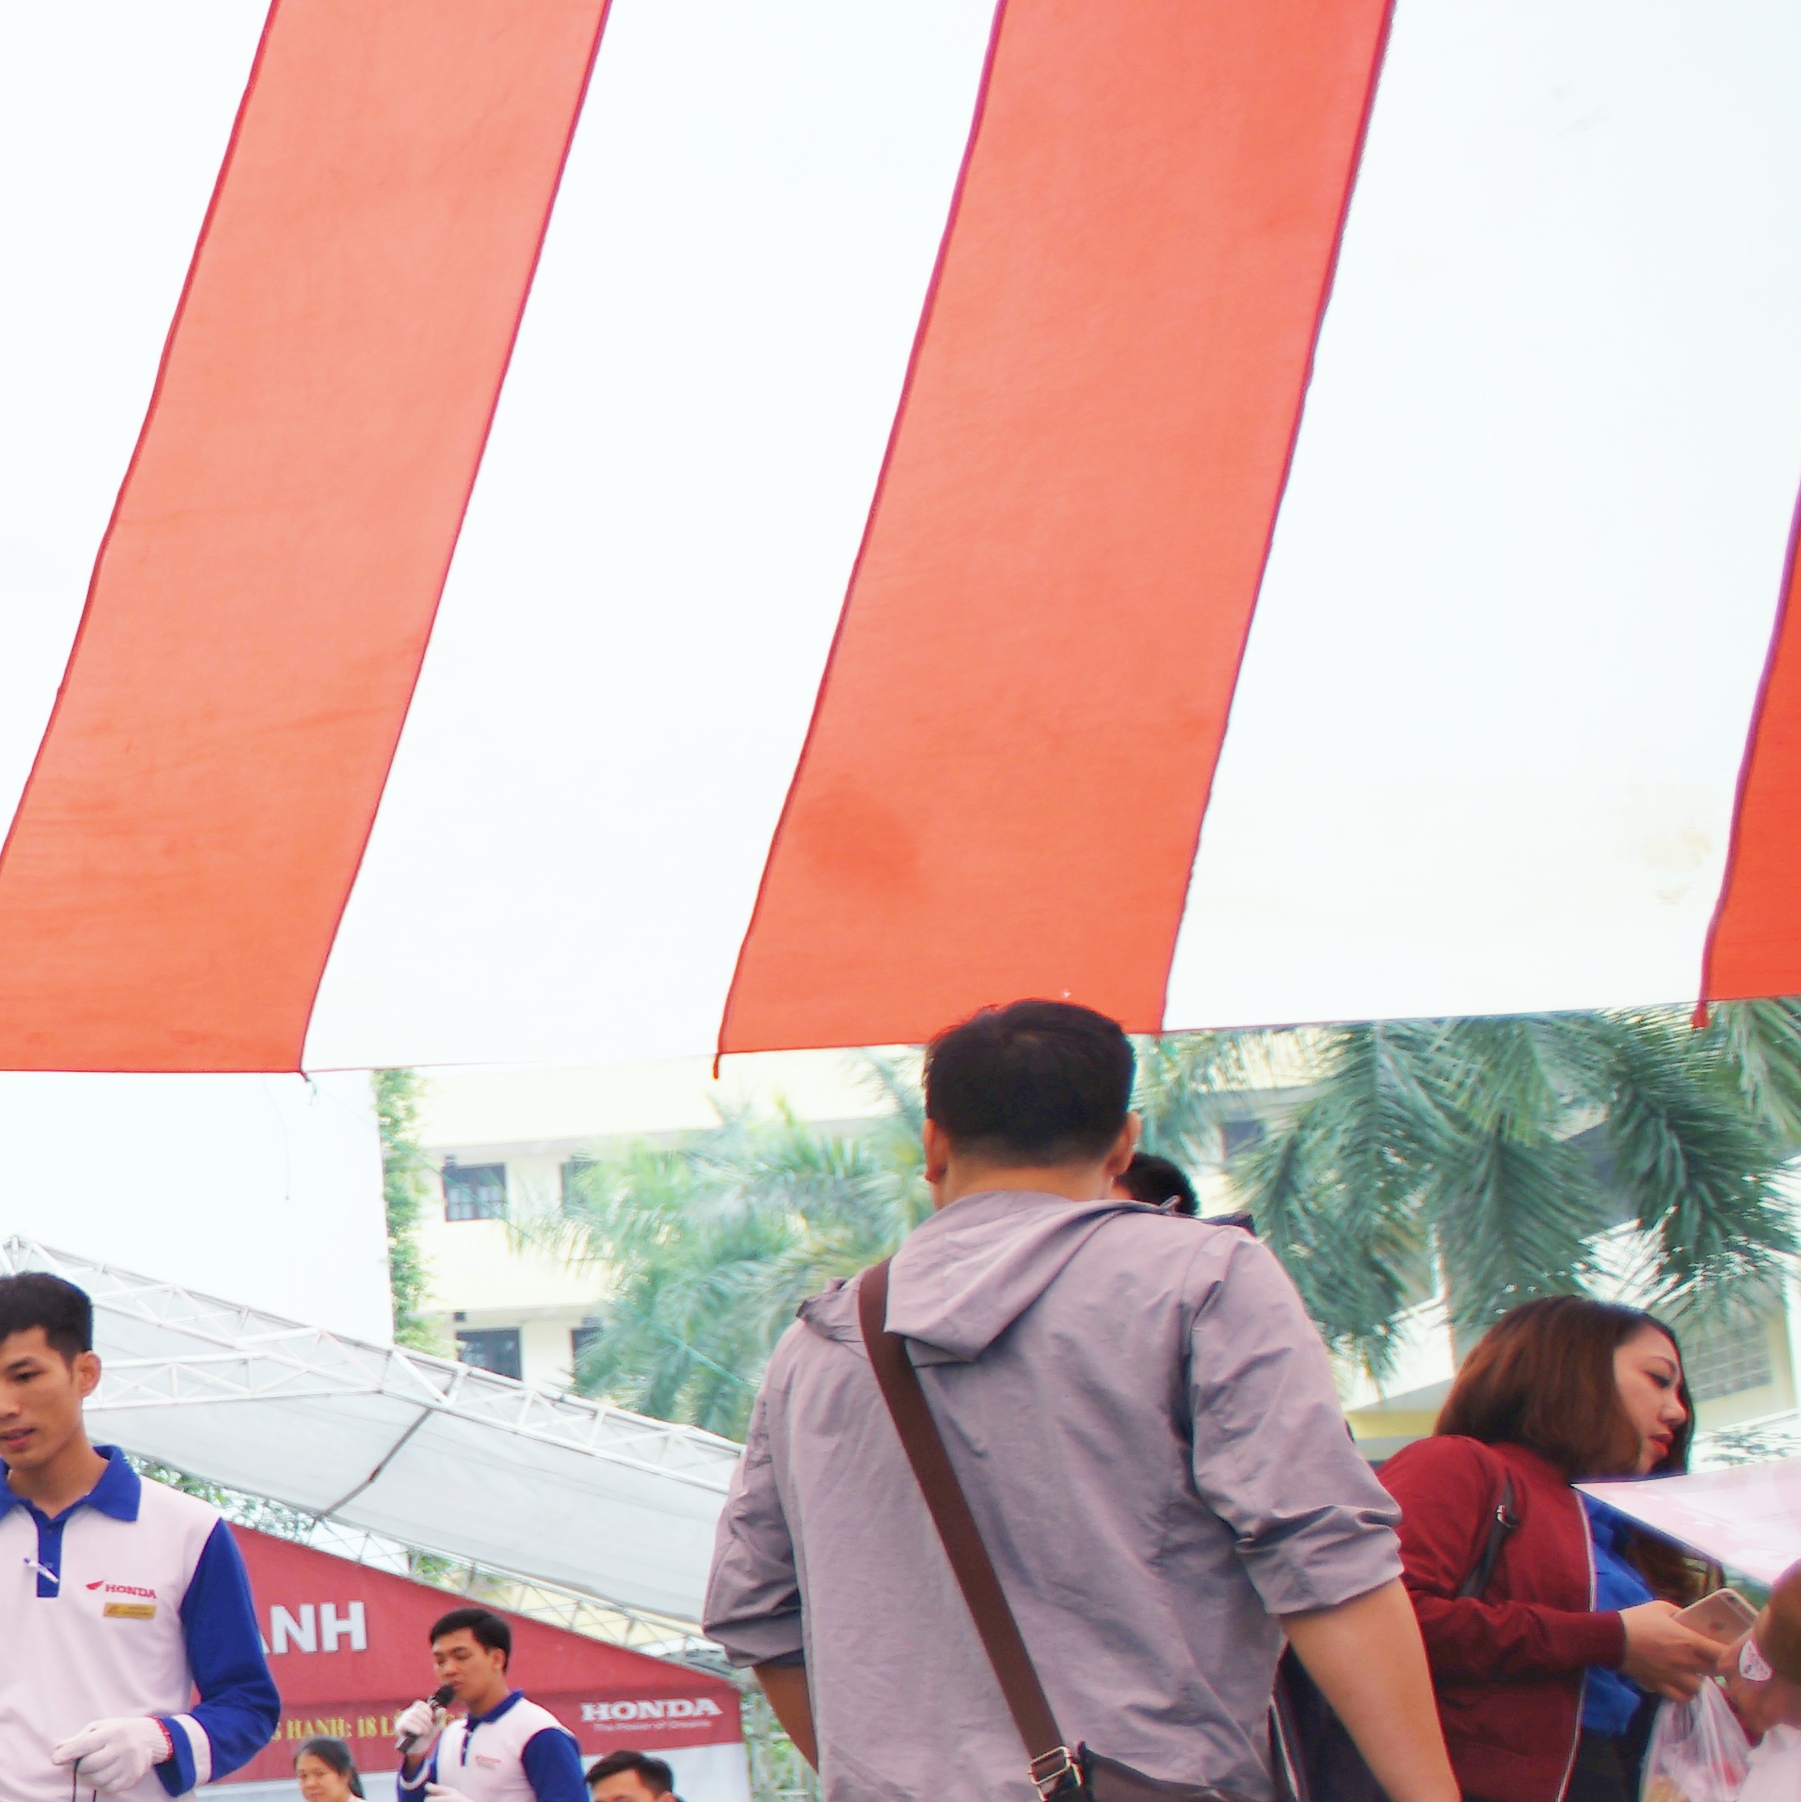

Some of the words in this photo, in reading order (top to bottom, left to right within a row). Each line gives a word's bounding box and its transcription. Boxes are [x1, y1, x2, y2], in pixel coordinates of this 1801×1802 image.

[104, 1584, 158, 1600] HONDA
[260, 1600, 368, 1655] NH
[580, 1697, 724, 1723] HONDA
